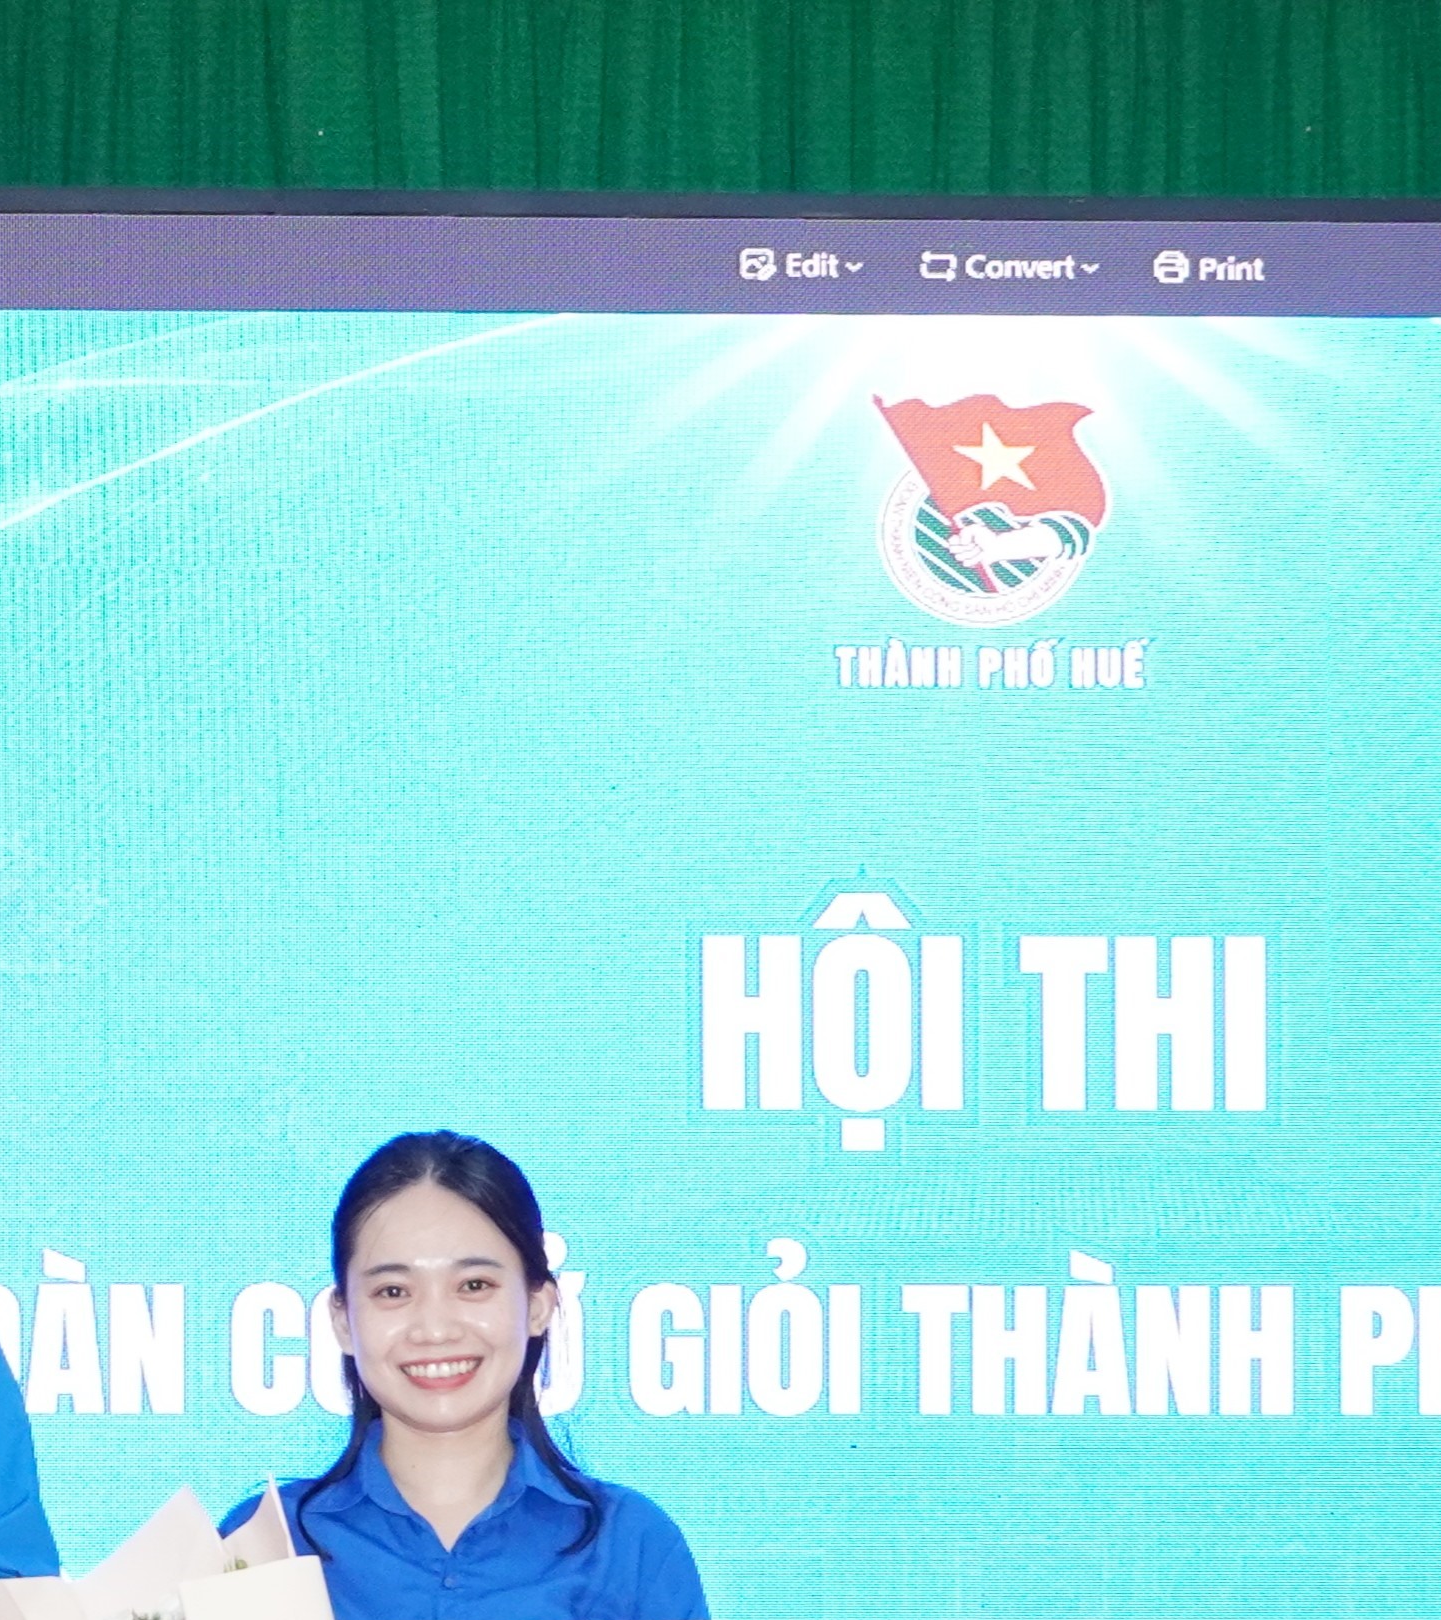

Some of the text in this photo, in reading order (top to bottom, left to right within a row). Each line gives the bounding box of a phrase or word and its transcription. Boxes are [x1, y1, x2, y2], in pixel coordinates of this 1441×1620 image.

[786, 252, 840, 279] Edit
[965, 254, 1076, 281] Convert
[1198, 255, 1266, 283] Print
[835, 637, 1152, 689] THÀNH PHỐ HUẾ
[704, 893, 1267, 1153] HỘI THI
[629, 1239, 862, 1418] GIỎI
[902, 1252, 1295, 1418] THÀNH
